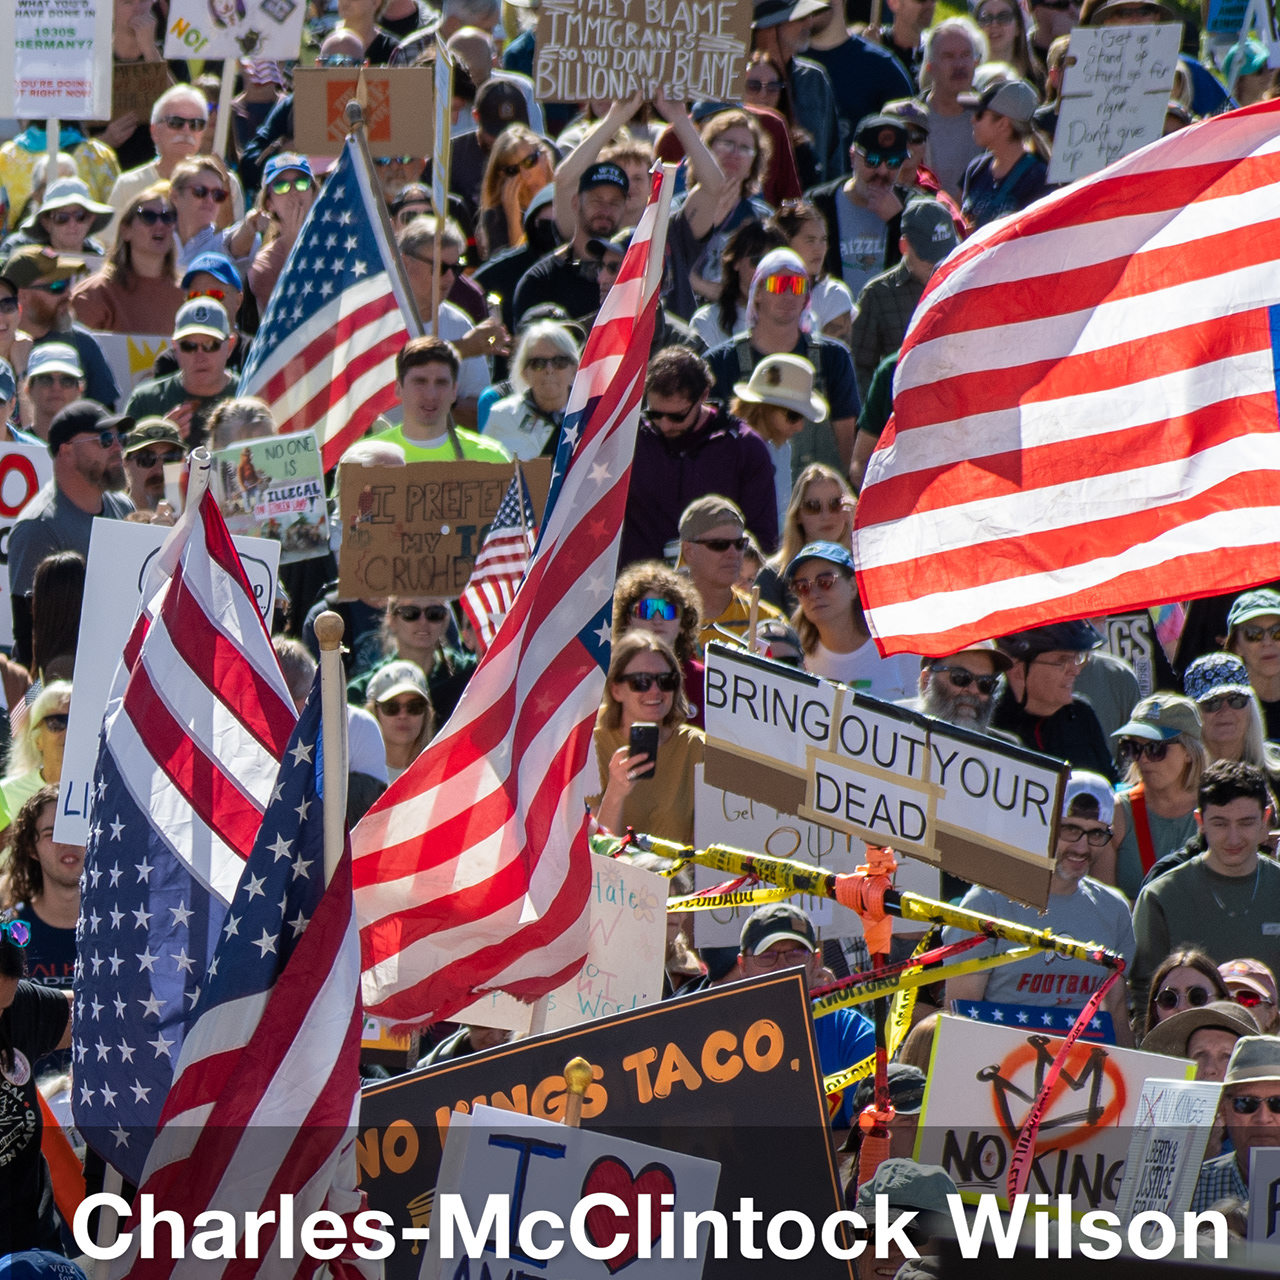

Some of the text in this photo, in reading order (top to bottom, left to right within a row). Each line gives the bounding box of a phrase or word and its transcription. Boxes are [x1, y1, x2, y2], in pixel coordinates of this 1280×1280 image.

[15, 10, 78, 19] HAVE DONE
[34, 27, 76, 38] 1930S
[170, 17, 210, 53] NO!
[544, 11, 697, 49] IMMIGRANTS
[15, 39, 93, 50] GERMANY?
[558, 49, 744, 100] SO YOU DON'T BLAME
[23, 89, 62, 98] RIGHT
[265, 436, 315, 460] NO ONE
[284, 460, 297, 477] IS
[266, 480, 321, 502] ILLEGAL
[706, 667, 1051, 826] BRING OUT YOUR
[815, 771, 927, 842] DEAD
[942, 1129, 1006, 1182] NO
